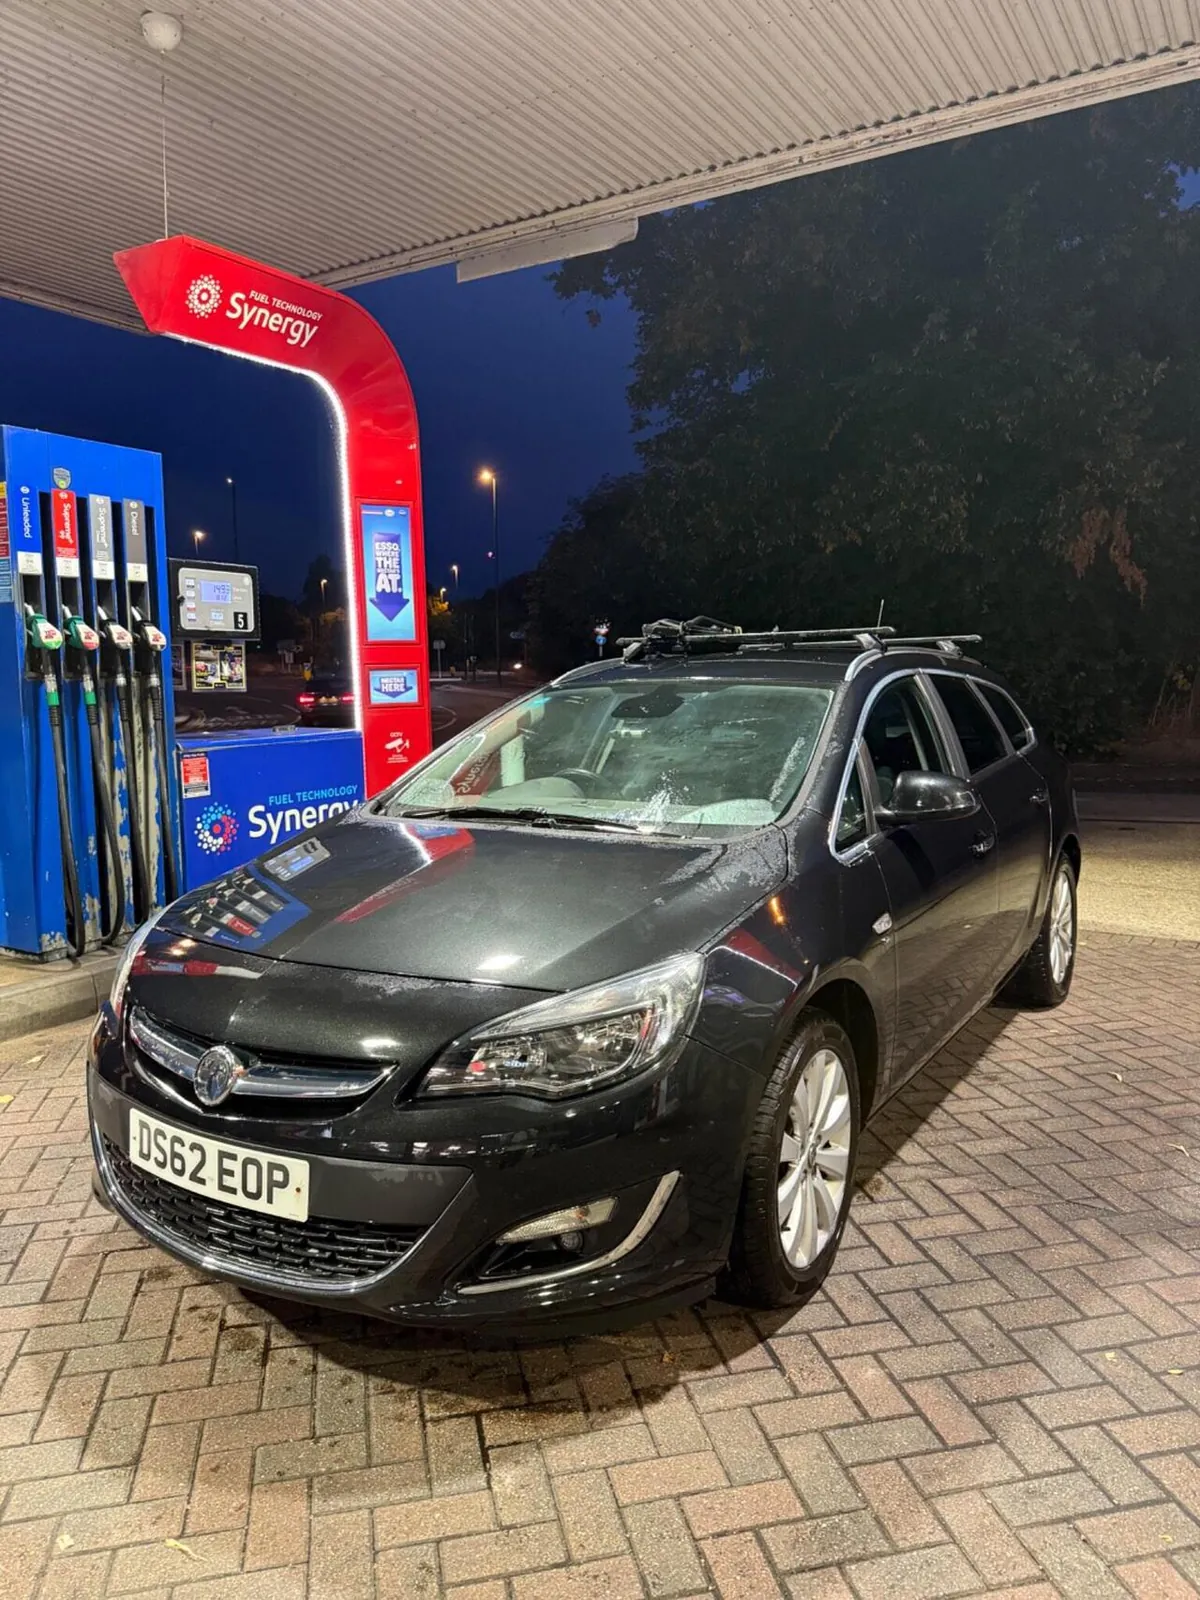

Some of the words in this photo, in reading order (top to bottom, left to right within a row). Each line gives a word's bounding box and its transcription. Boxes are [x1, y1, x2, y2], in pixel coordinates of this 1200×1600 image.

[249, 290, 270, 305] FUEL
[272, 297, 324, 321] TECHNOLOGY
[225, 291, 319, 348] Synergy
[21, 497, 33, 539] Unleaded
[130, 511, 139, 537] Diesel
[376, 556, 400, 569] THE
[376, 573, 402, 593] AT.
[237, 613, 245, 629] 5
[381, 683, 406, 692] HERE
[269, 795, 294, 806] FUEL
[295, 784, 358, 802] TECHNOLOGY
[137, 1118, 207, 1186] DS62
[217, 1148, 290, 1205] EOP
